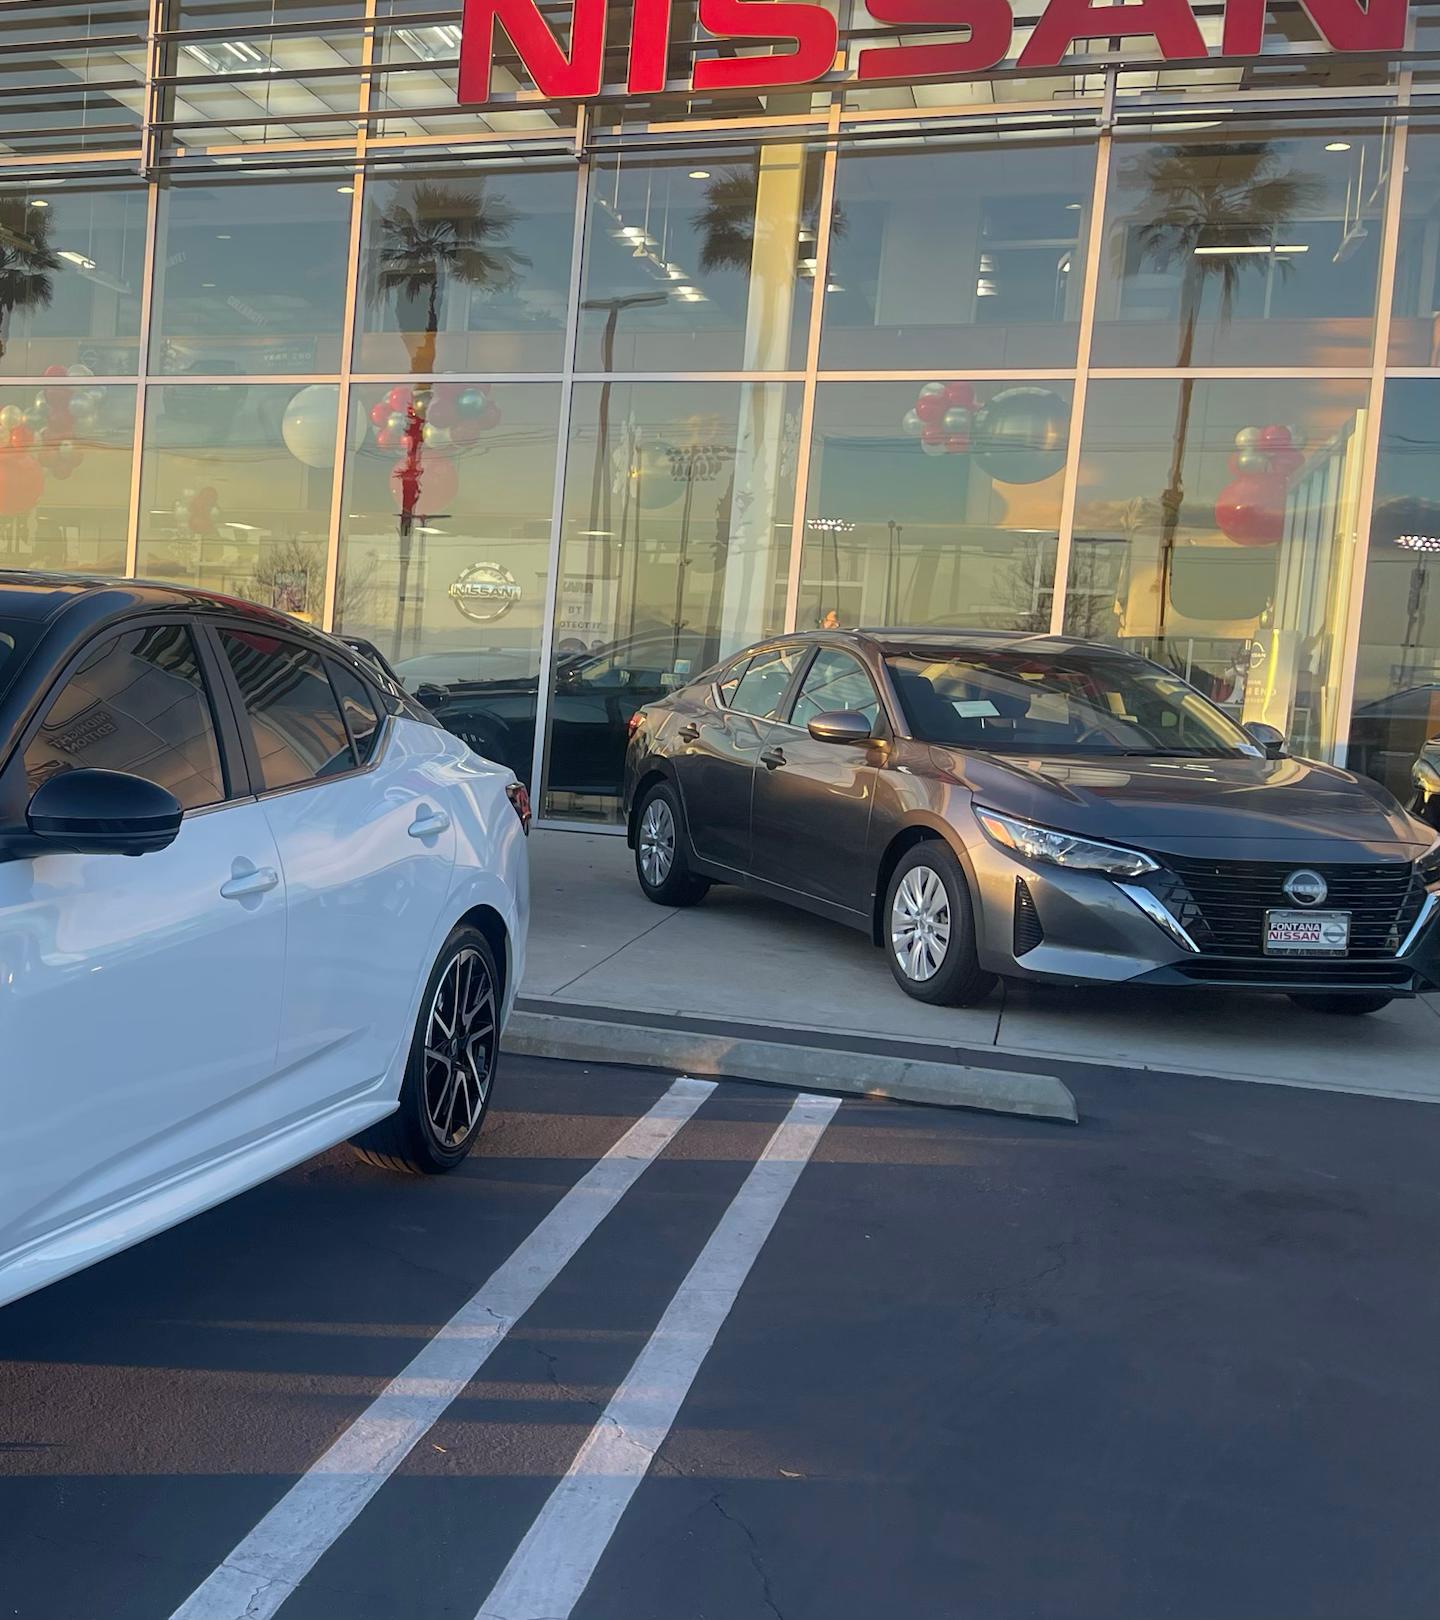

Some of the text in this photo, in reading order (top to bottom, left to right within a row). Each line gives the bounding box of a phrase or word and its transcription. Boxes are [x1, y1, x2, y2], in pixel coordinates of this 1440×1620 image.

[454, 585, 513, 599] NISSAN
[1270, 922, 1320, 931] FONTANA
[1269, 931, 1320, 941] NISSAN
